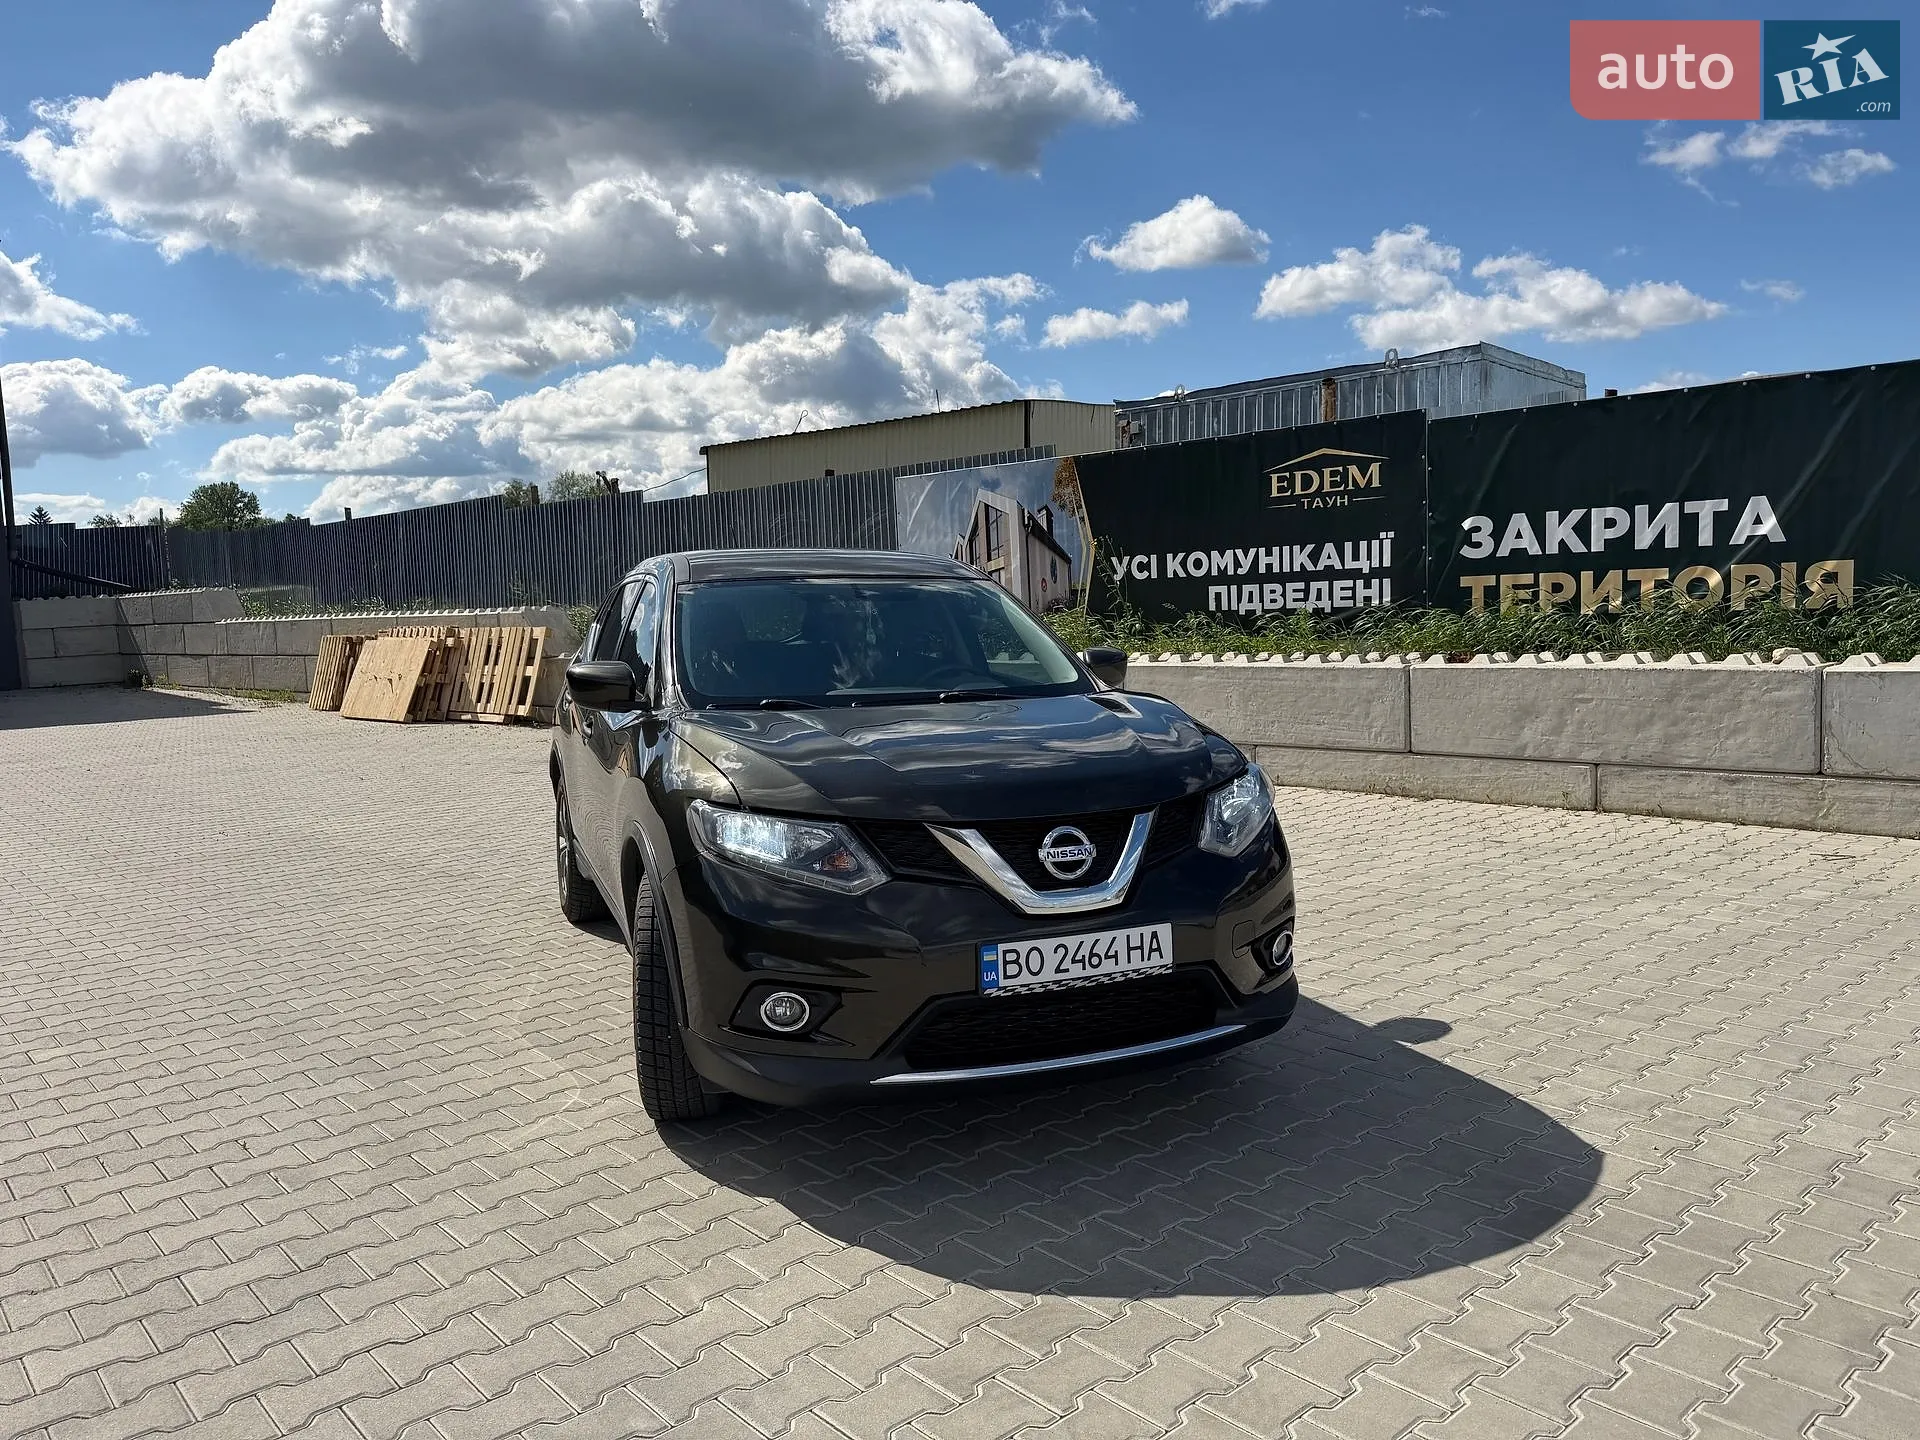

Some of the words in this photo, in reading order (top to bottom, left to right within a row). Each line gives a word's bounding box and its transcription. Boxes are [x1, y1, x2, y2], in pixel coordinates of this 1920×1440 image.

[1269, 461, 1382, 498] EDEM
[1300, 494, 1349, 510] ТАУН
[1459, 495, 1786, 559] ЗАКРИТА
[1110, 554, 1159, 581] УСІ
[1166, 531, 1395, 579] КОМУНІКАЦІЇ
[1207, 578, 1391, 615] ПІДВЕДЕНІ
[1459, 559, 1855, 615] ТЕРИТОРІЯ
[1045, 847, 1093, 860] NISSAN
[1002, 946, 1045, 980] BO
[1053, 936, 1119, 975] 2464
[1126, 930, 1164, 964] HA
[983, 971, 998, 982] UA
